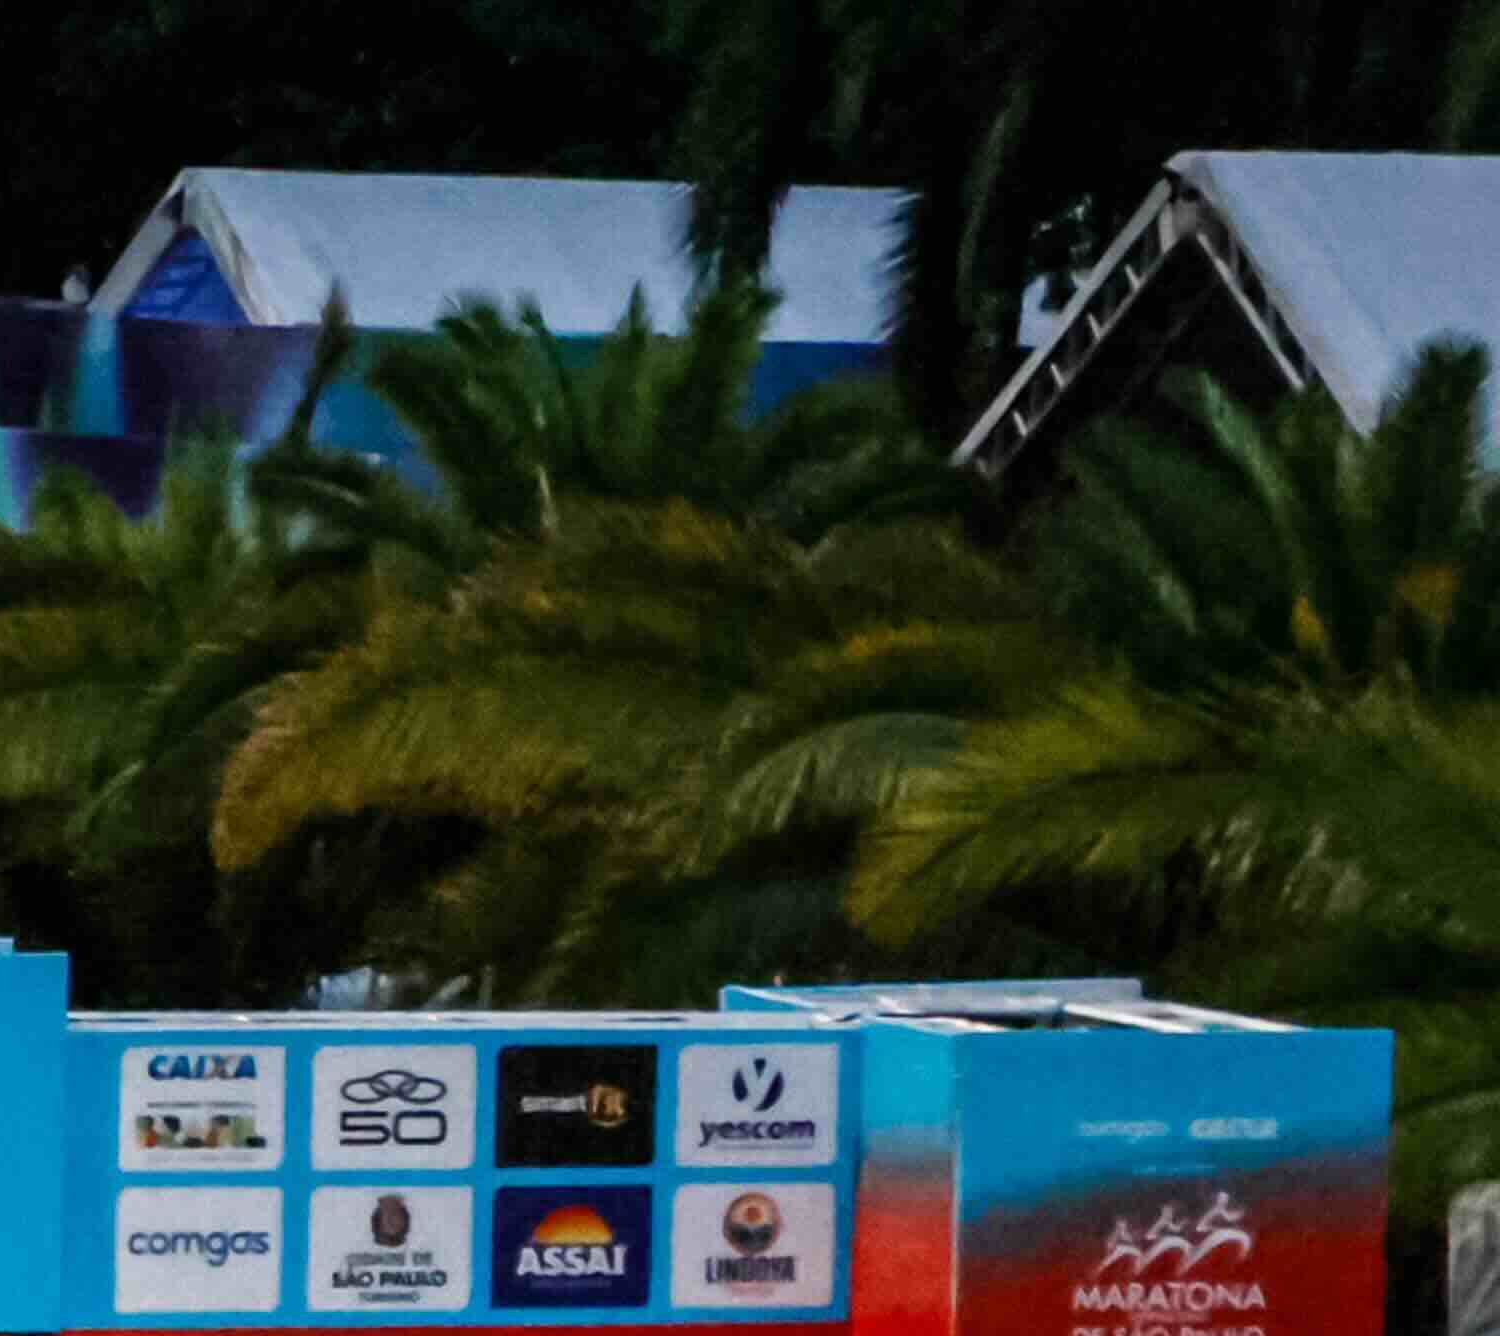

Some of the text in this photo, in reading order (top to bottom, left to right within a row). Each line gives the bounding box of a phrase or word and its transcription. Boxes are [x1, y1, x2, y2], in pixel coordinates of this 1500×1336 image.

[147, 1054, 258, 1081] CAIXA
[339, 1111, 447, 1145] 50
[699, 1118, 815, 1147] yescom
[381, 1270, 448, 1289] PAULO
[1071, 1282, 1266, 1311] MARATONA
